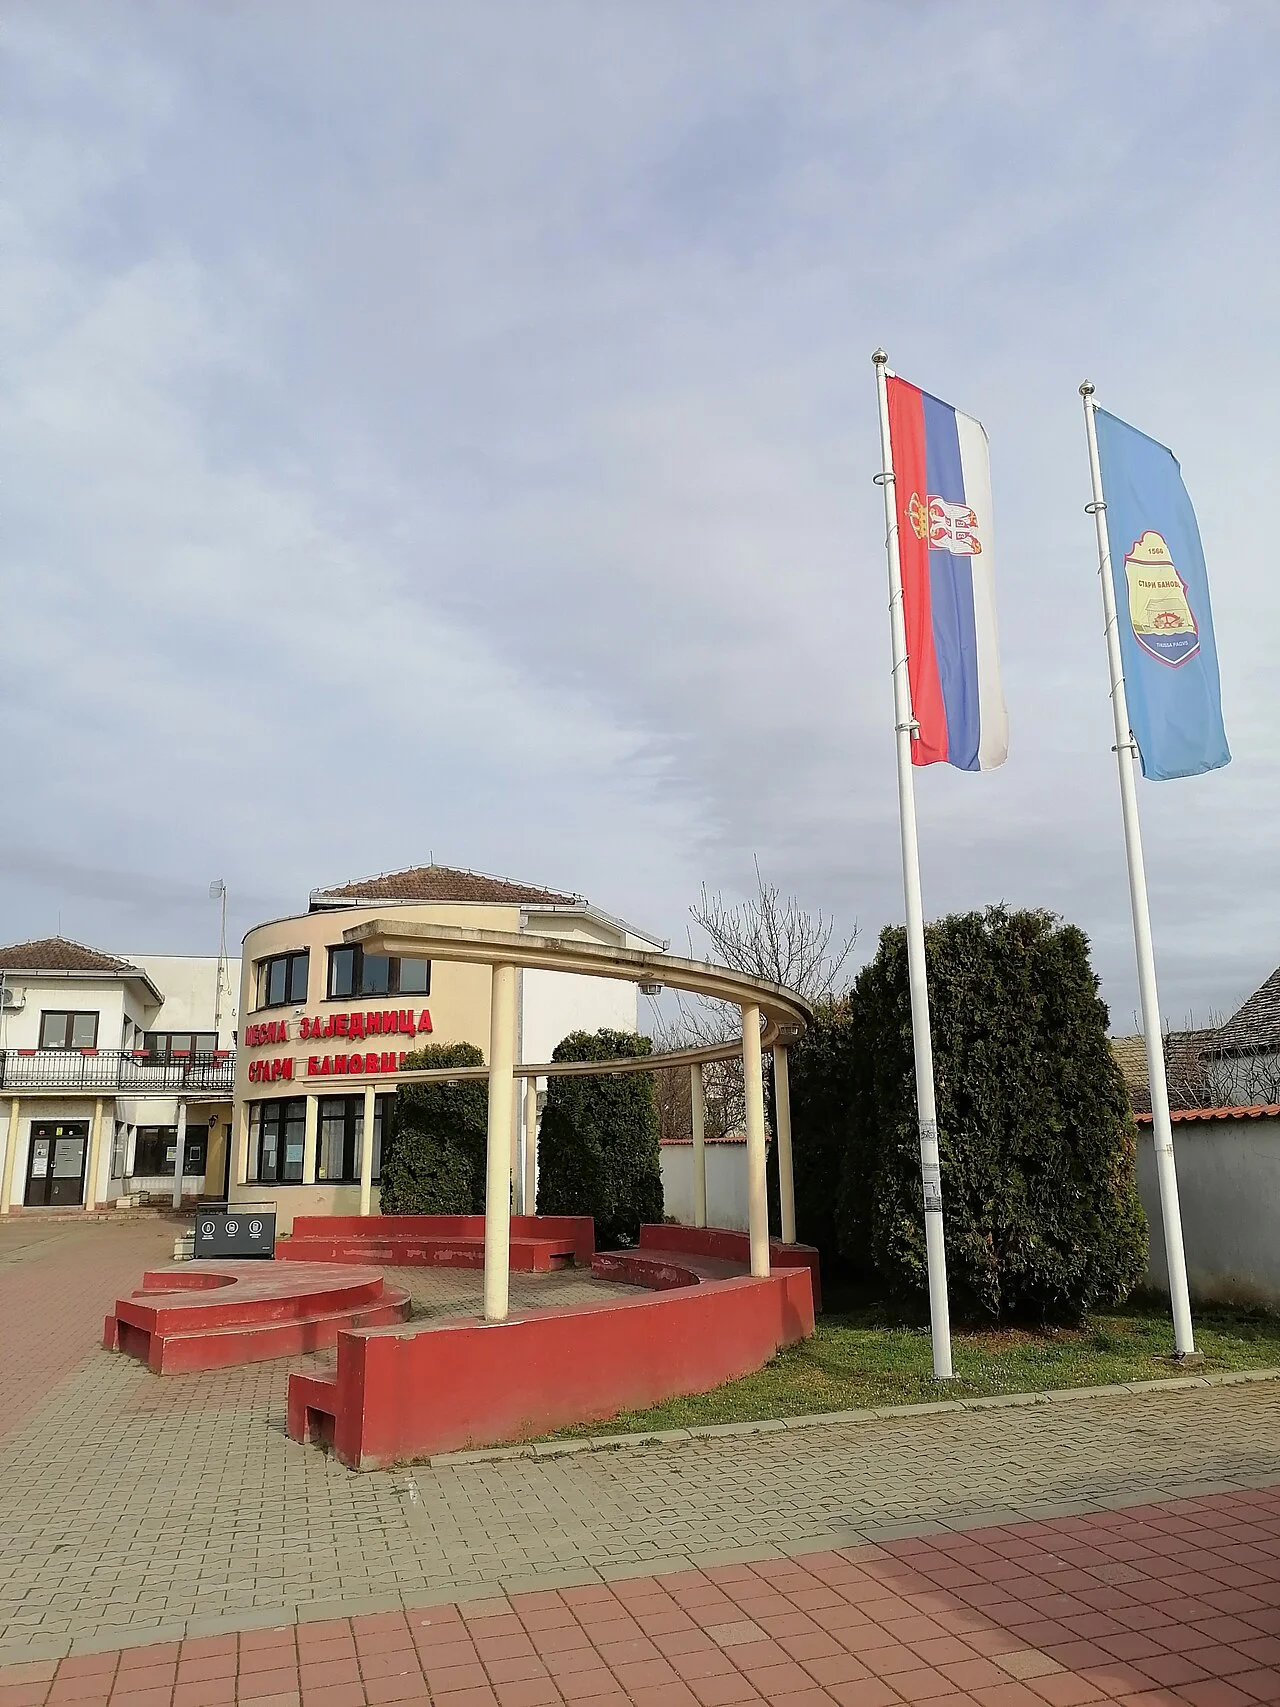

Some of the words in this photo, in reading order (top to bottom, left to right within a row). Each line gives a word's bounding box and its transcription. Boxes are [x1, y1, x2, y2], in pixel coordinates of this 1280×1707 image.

[1138, 580, 1156, 589] СТАРИ
[299, 1009, 434, 1040] ЗАЈЕДНИЦА
[248, 1057, 294, 1083] СТАРИ
